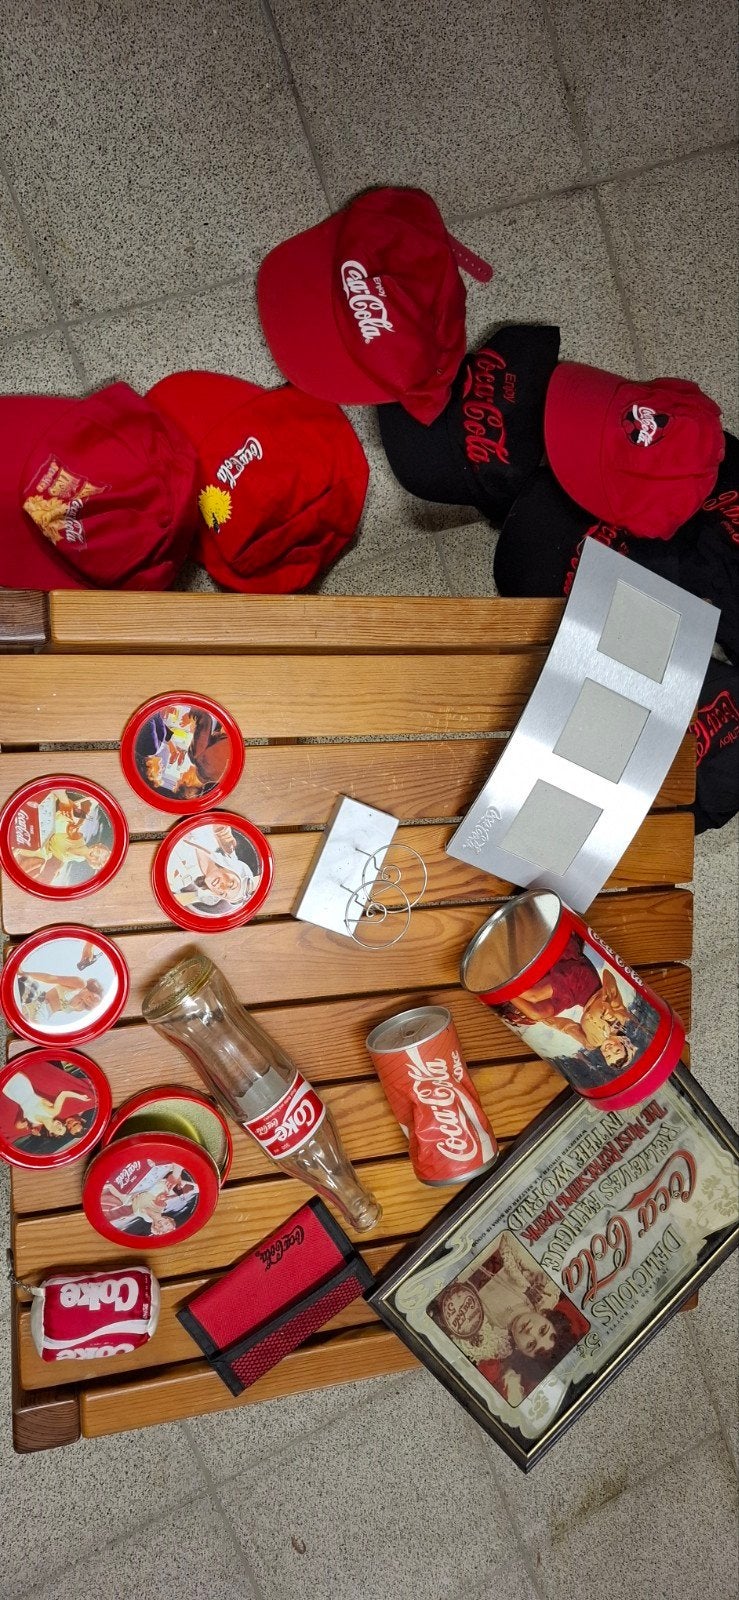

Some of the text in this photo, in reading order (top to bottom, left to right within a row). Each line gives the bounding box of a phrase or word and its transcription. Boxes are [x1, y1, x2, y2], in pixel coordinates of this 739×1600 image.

[373, 276, 387, 297] Enjoy
[463, 351, 511, 464] Coca-Cola
[501, 372, 517, 405] Enjoy
[218, 437, 262, 489] Coca-Cola
[590, 928, 644, 987] CocaCola
[274, 1100, 315, 1141] Coke
[407, 1057, 477, 1161] Coca-Cola
[599, 1111, 626, 1136] IN
[562, 1130, 587, 1155] WHEREVER
[568, 1127, 609, 1167] THE
[521, 1101, 667, 1244] THE MOST REFRESHING DRINK
[542, 1156, 561, 1175] GINGER
[538, 1120, 682, 1272] RELIEVES FATIGUE
[257, 1225, 304, 1271] Coca-Cola
[60, 1277, 139, 1312] Coke
[590, 1226, 683, 1326] DELICIOUS
